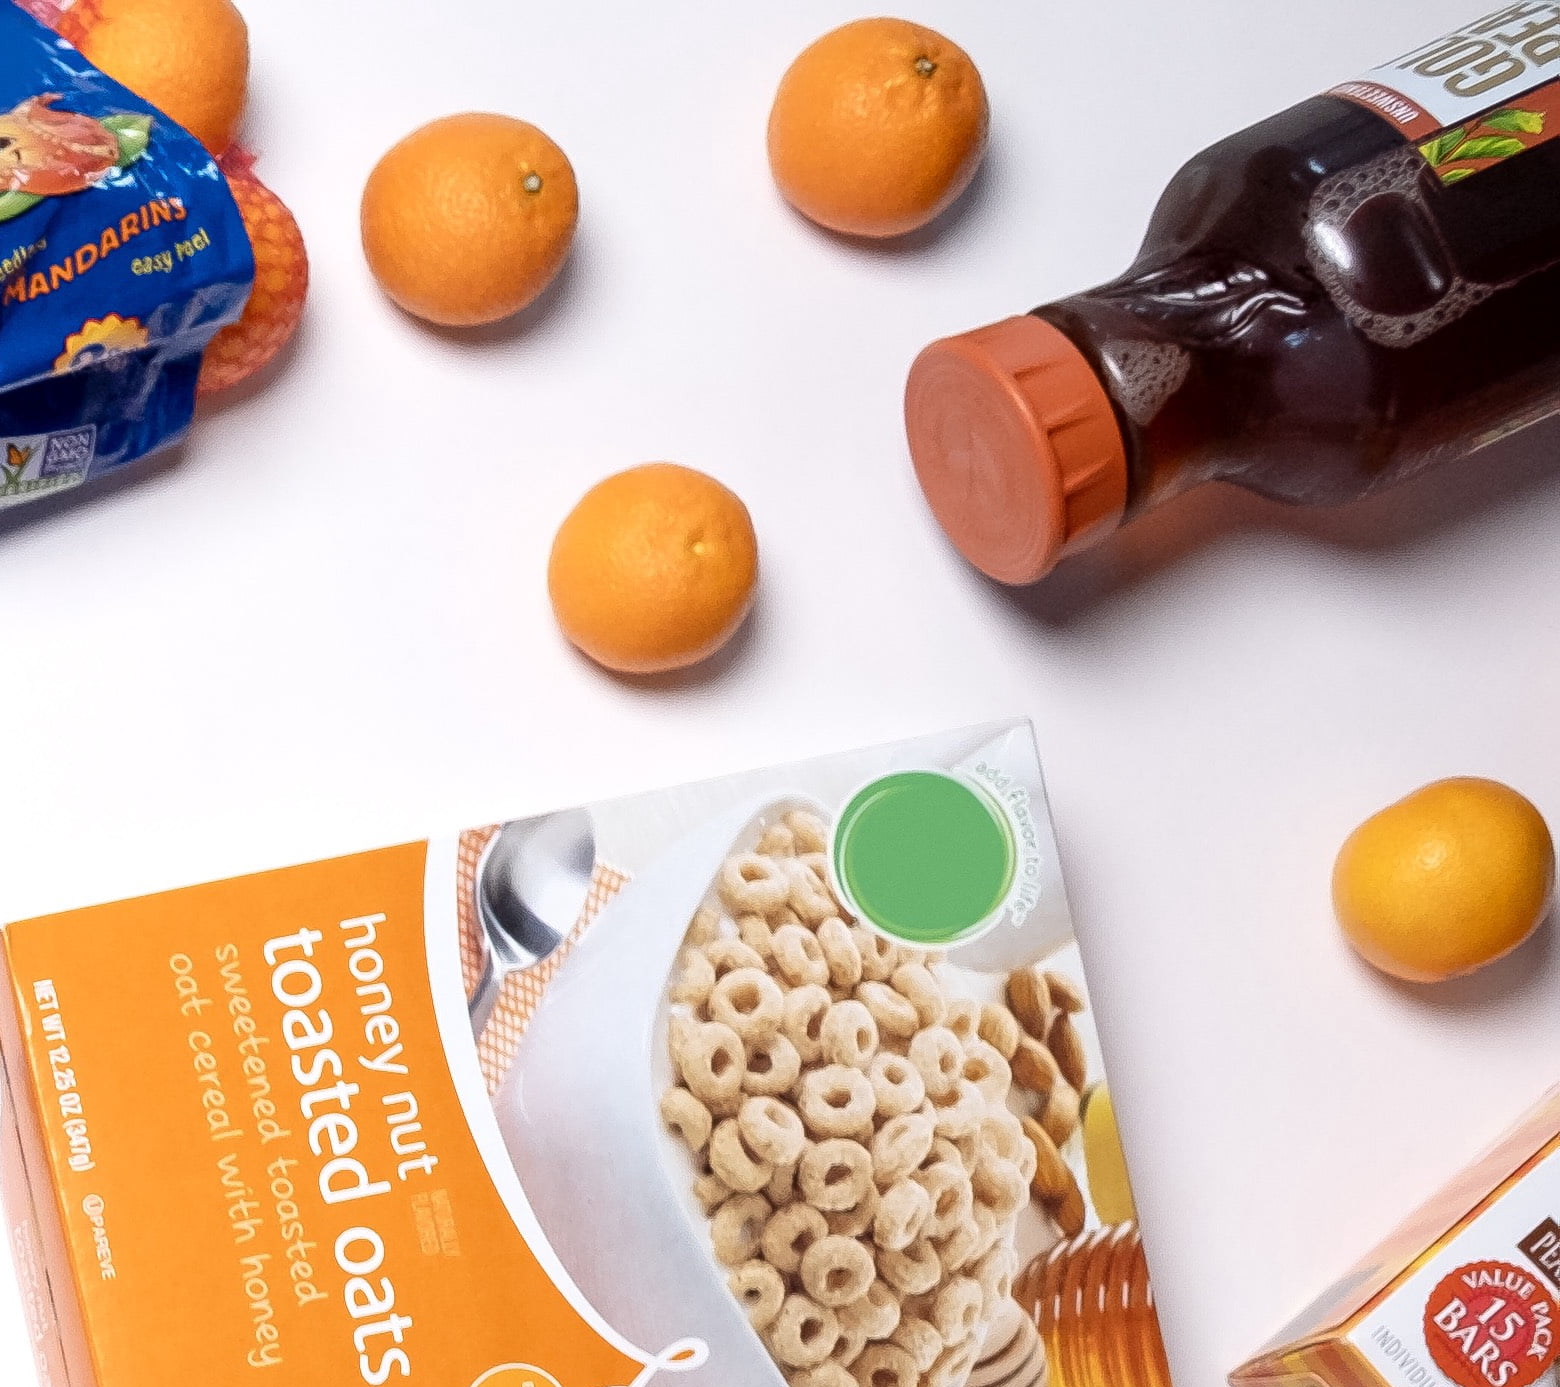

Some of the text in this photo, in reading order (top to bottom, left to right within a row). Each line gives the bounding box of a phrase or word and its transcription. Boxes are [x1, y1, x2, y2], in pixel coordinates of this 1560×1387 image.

[3, 197, 187, 305] MANDARINS
[131, 250, 172, 275] easy
[339, 912, 440, 1181] honey nut
[169, 952, 284, 1369] oat cereal with honey
[214, 942, 329, 1308] sweetened toasted
[263, 927, 414, 1386] toasted oats
[90, 1212, 117, 1282] PAREVE
[1461, 1268, 1536, 1300] VALUE
[1432, 1296, 1518, 1387] BARS
[1477, 1296, 1525, 1343] 15
